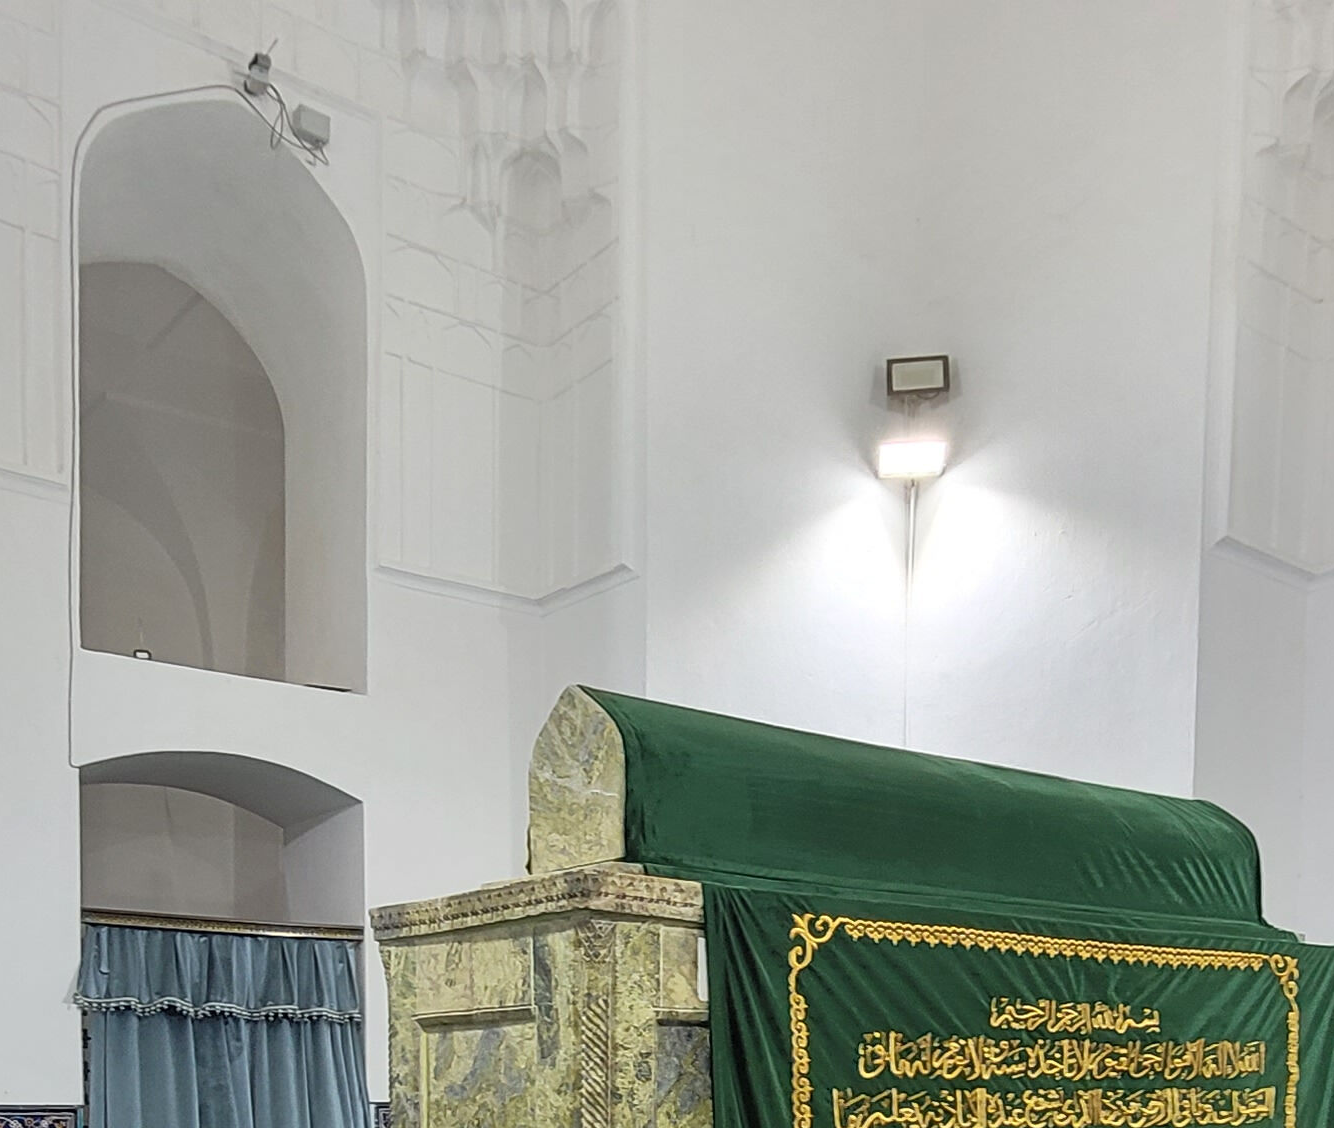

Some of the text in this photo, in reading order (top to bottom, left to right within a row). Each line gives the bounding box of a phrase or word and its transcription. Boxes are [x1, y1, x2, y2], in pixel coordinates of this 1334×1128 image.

[989, 996, 1056, 1032] الرحيم
[1046, 1001, 1092, 1035] الرحمن
[1092, 1001, 1131, 1030] الله
